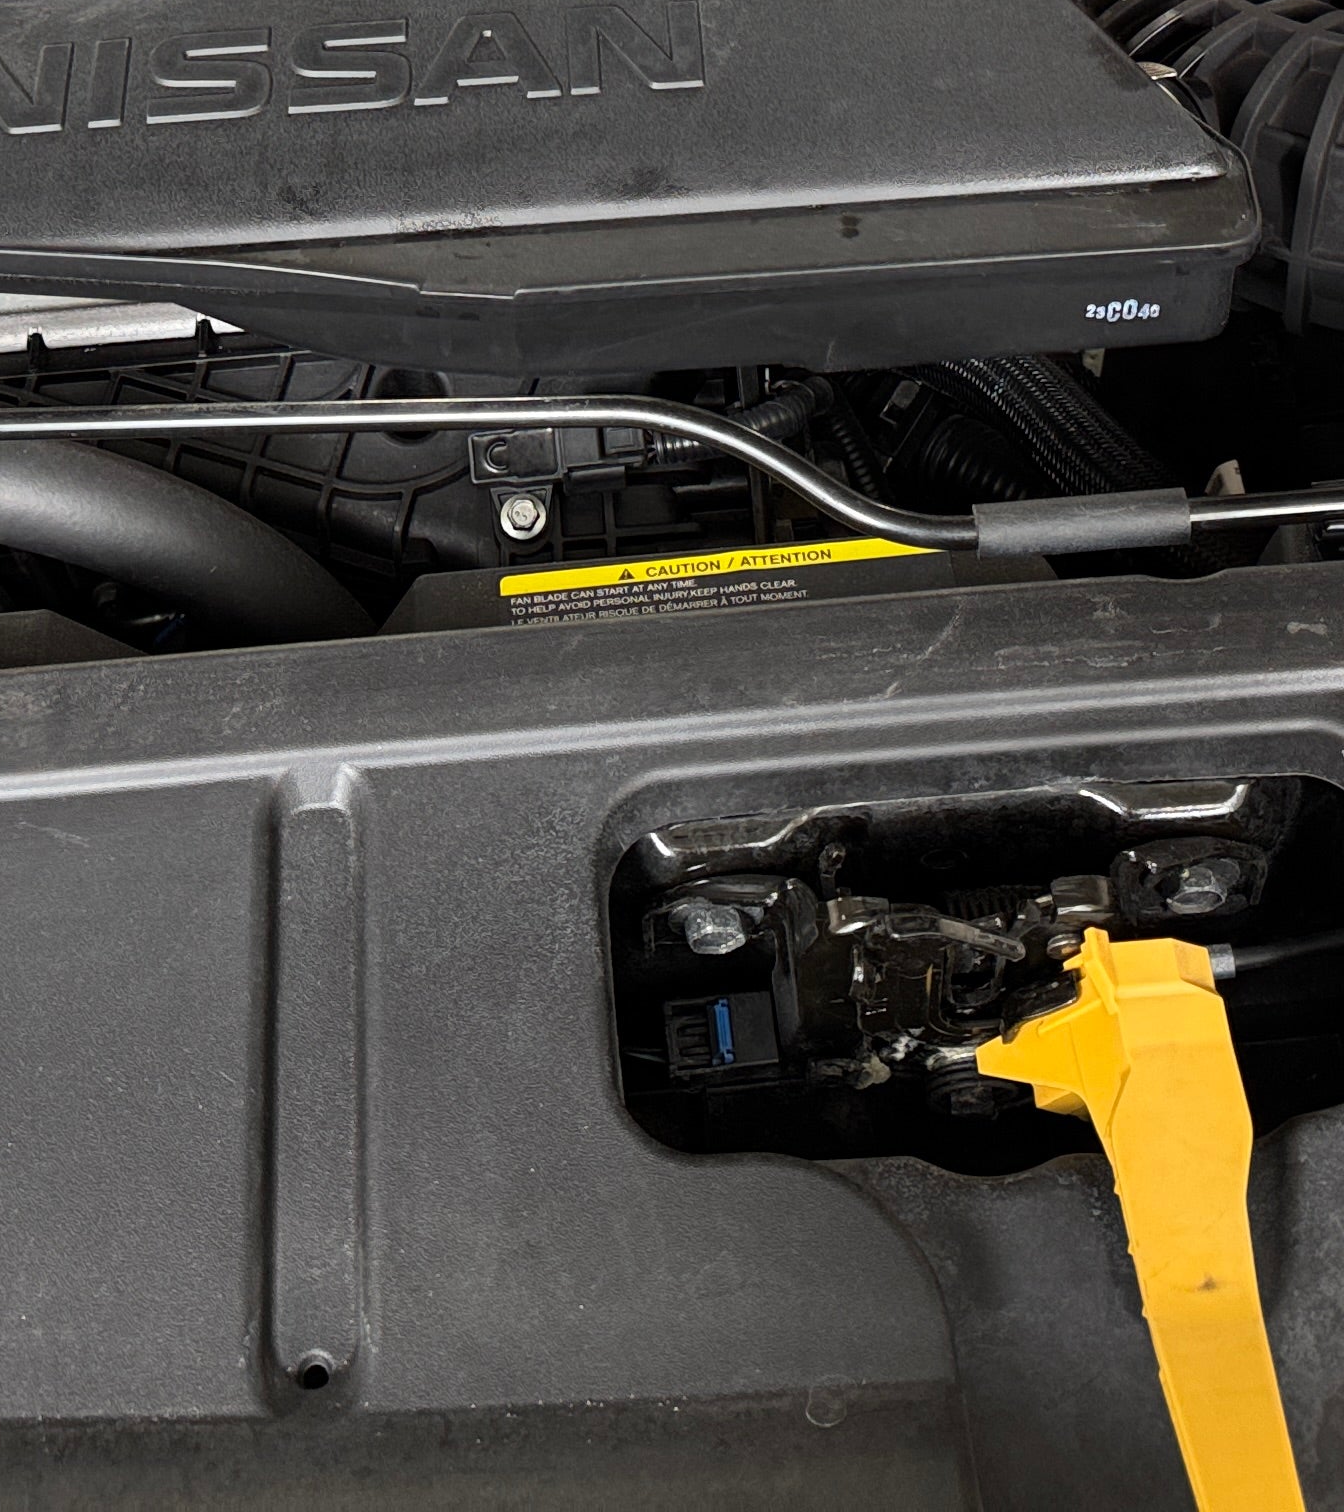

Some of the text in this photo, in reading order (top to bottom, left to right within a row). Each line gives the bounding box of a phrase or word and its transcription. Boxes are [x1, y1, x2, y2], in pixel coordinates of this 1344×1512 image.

[645, 549, 832, 578] CAUTION / ATTENTION
[510, 596, 532, 606] FAN
[533, 592, 569, 604] BLADE
[570, 590, 595, 601] CAN
[596, 586, 631, 599] START
[632, 585, 646, 595] AT
[646, 582, 668, 593] ANY
[511, 607, 526, 616] TO
[527, 604, 556, 615] HELP
[558, 601, 591, 612] AVOID
[593, 594, 651, 608] PERSONAL
[720, 582, 758, 594] HANDS
[598, 606, 640, 618] RISQUE
[642, 604, 655, 615] DE
[659, 598, 718, 612] DÉMARRER
[730, 593, 758, 605] TOUT
